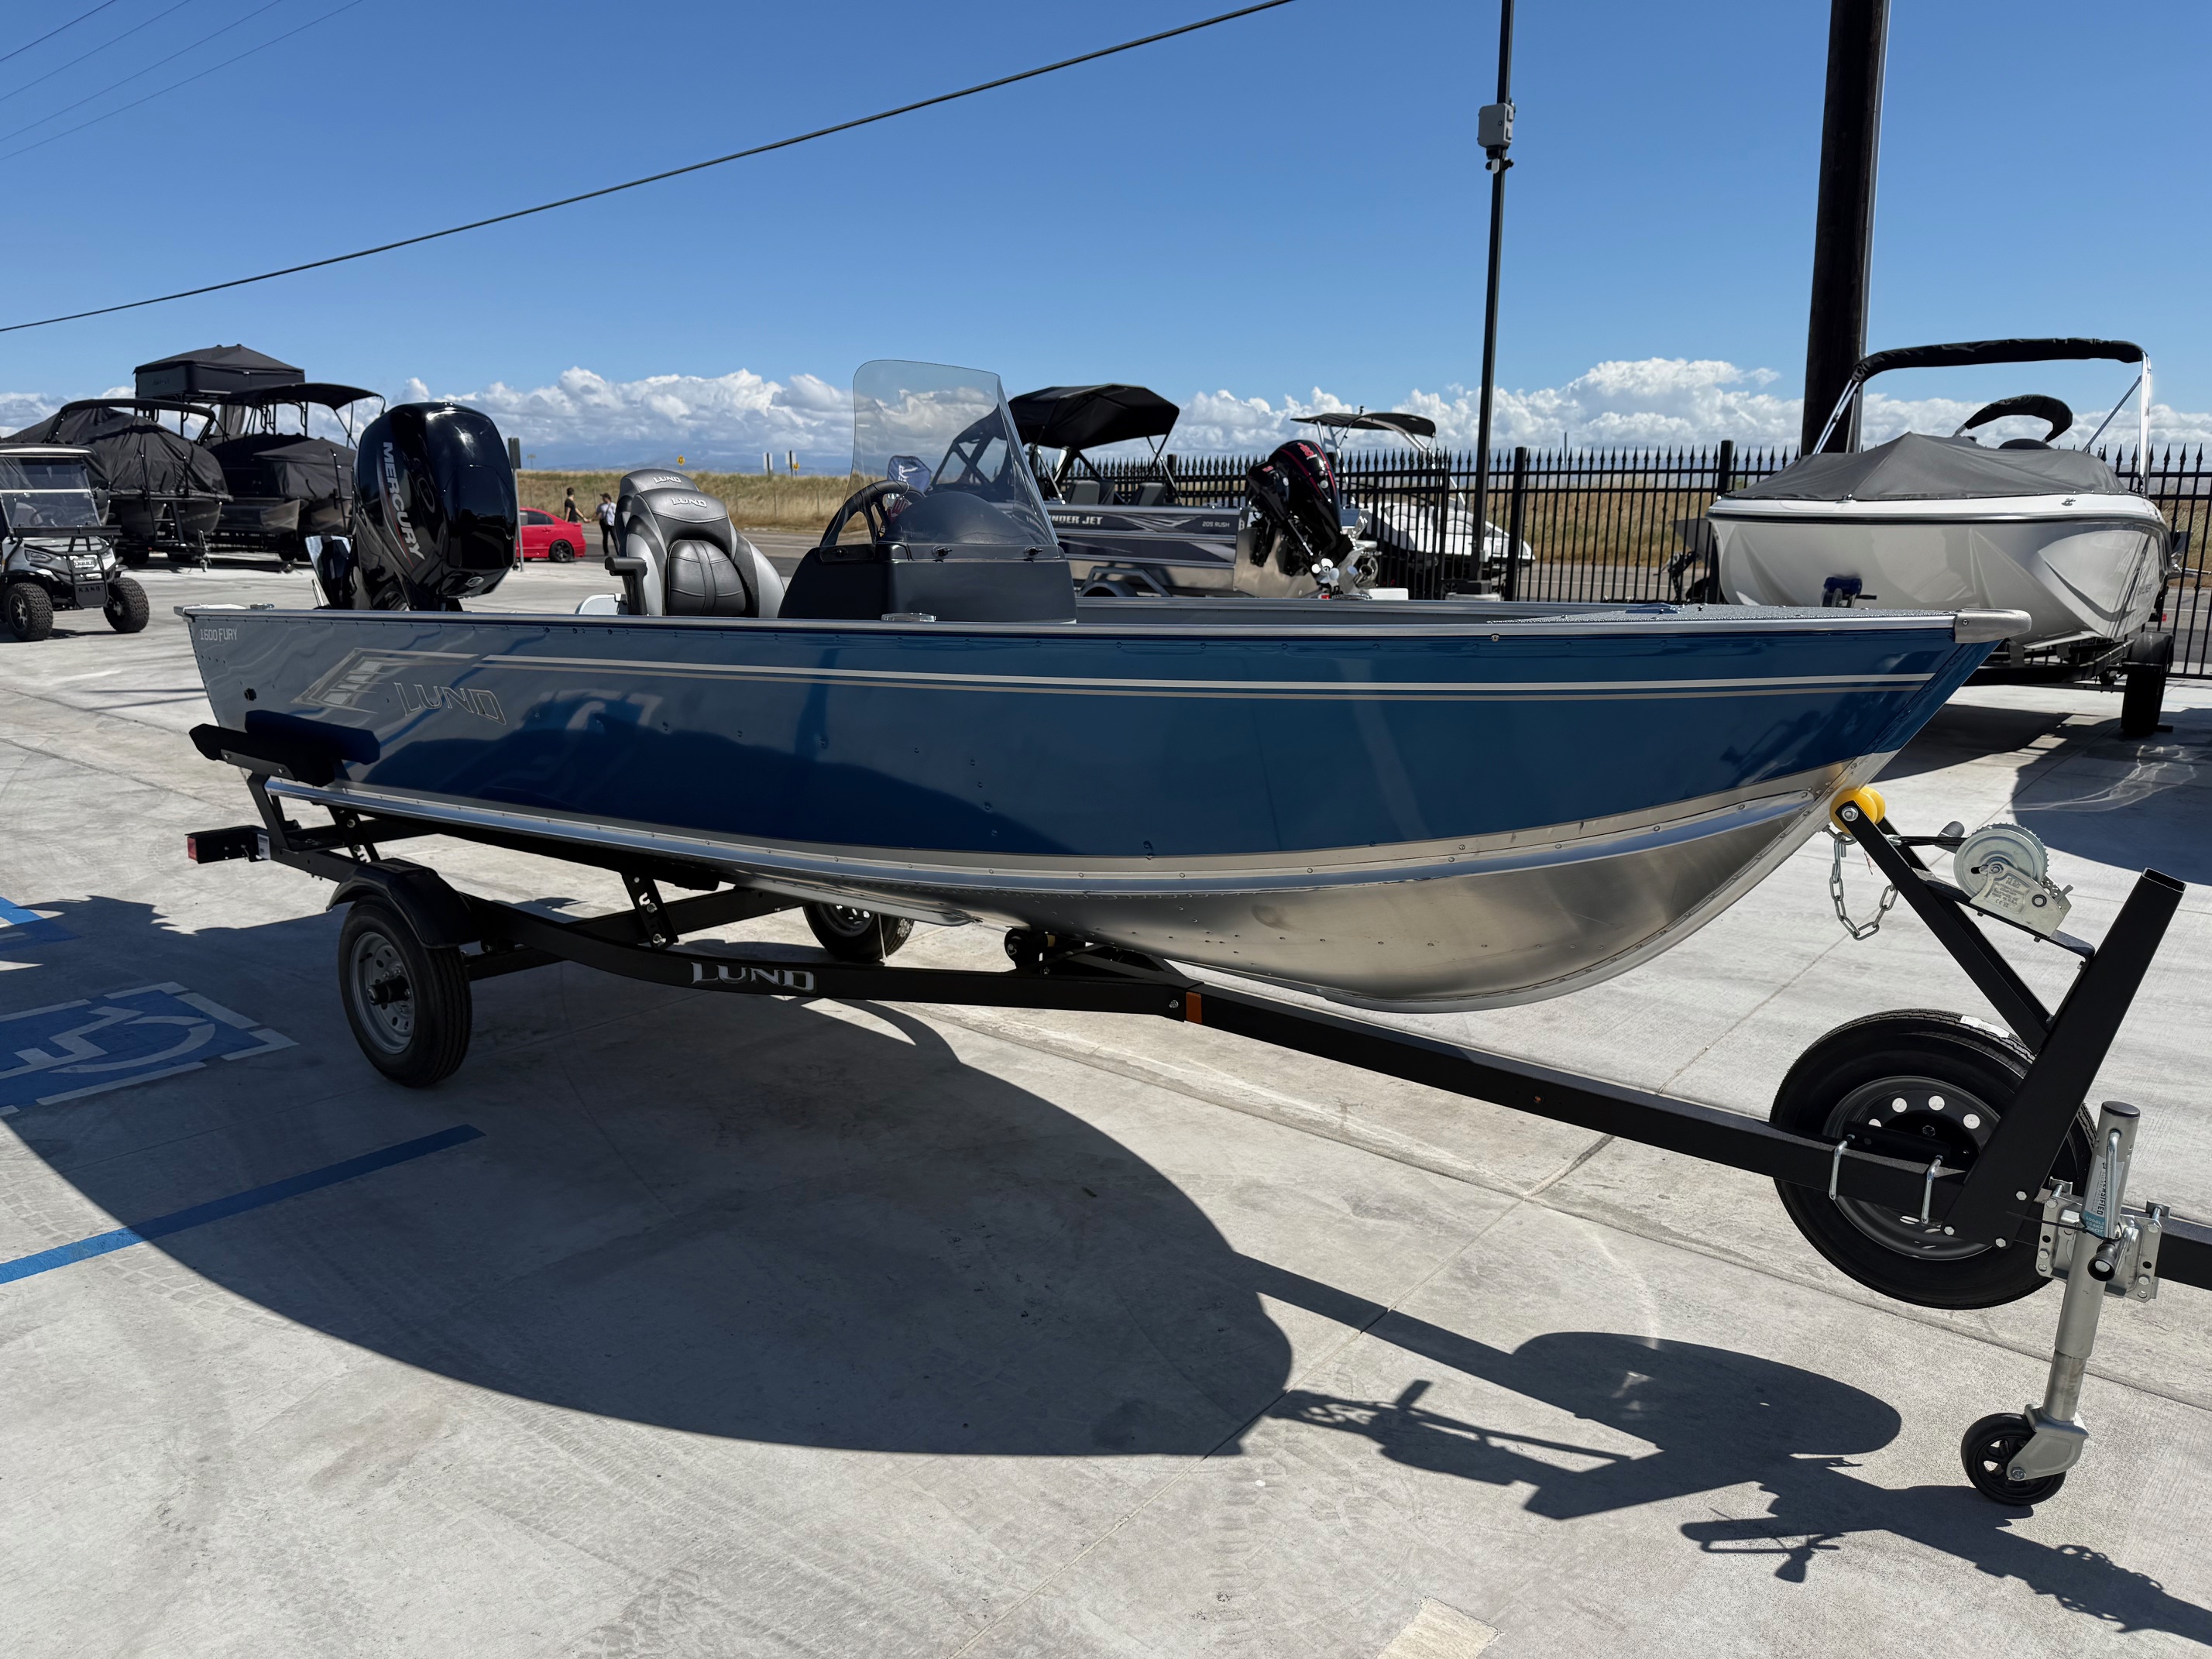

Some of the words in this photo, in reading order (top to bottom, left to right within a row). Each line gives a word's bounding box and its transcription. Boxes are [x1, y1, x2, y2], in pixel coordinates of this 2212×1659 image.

[653, 476, 682, 484] LUND
[383, 441, 425, 560] MERCURY
[671, 497, 708, 508] LUND
[1081, 516, 1104, 525] JET
[200, 628, 218, 641] 1600
[218, 627, 237, 642] FURY
[393, 682, 507, 726] LUND
[691, 962, 816, 993] LUND
